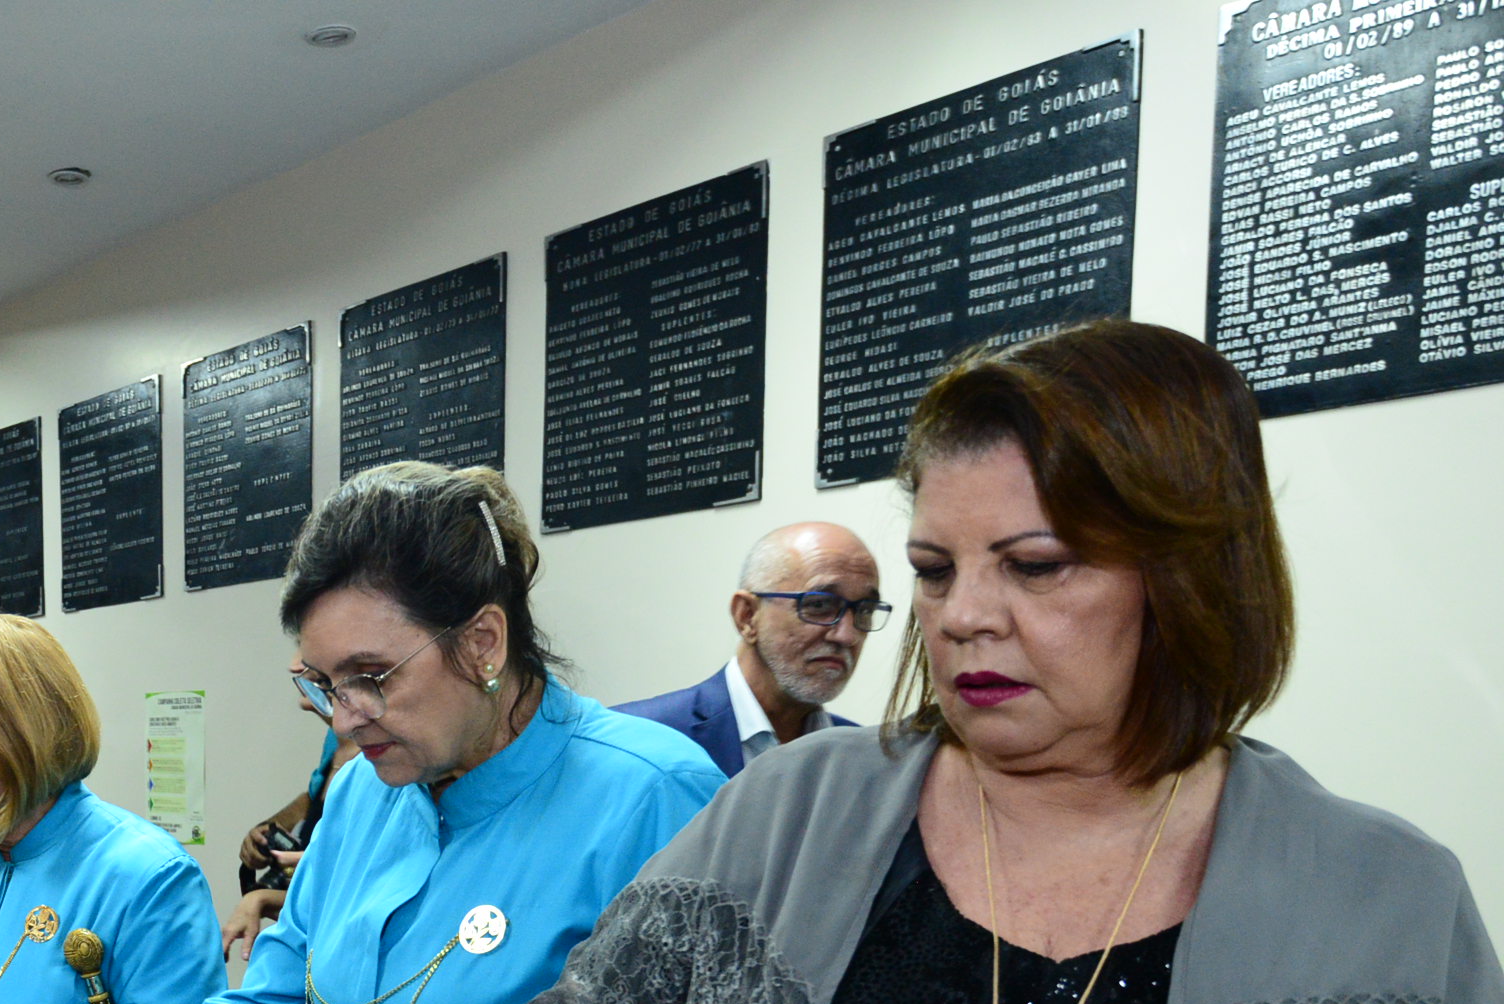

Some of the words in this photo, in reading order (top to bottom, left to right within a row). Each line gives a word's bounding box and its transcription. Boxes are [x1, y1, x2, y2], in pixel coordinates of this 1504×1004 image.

[1251, 1, 1342, 44] CÂMARA
[1265, 19, 1340, 60] DÉCIMA
[1349, 0, 1454, 33] PRIMEIR
[1323, 18, 1414, 62] 01/02/89
[1427, 10, 1440, 28] A
[1435, 58, 1479, 79] PAULO
[1436, 45, 1479, 67] PAULO
[1262, 60, 1360, 103] VEREADORES:
[1433, 78, 1500, 105] RONALDO
[1434, 71, 1480, 92] PEDRO
[887, 105, 950, 140] ESTADO
[962, 94, 983, 115] DE
[998, 68, 1059, 102] GOIÁS
[1225, 109, 1258, 127] AGEU
[1262, 86, 1338, 116] CAVALCANTE
[1342, 72, 1385, 93] LEMOS
[1433, 92, 1494, 118] ROSIRON
[835, 149, 896, 181] CÂMARA
[908, 116, 996, 158] MUNICIPAL
[1008, 106, 1029, 126] DE
[1040, 77, 1120, 116] GOIÂNIA
[1225, 117, 1275, 139] ANSELMO
[1278, 101, 1327, 124] PEREIRA
[1225, 127, 1276, 150] ANTÔNIO
[1281, 112, 1330, 134] CARLOS
[1334, 98, 1378, 119] RAMOS
[1430, 116, 1502, 144] SEBASTIÃO
[1431, 101, 1504, 131] SEBASTIÃO
[1047, 126, 1058, 140] A
[1224, 140, 1276, 162] ANTÔNIO
[1328, 107, 1393, 134] SOBRINHO
[1268, 150, 1286, 162] DE
[1288, 133, 1346, 157] ALENCAR
[1430, 136, 1478, 157] VALDIR
[1223, 166, 1269, 186] CARLOS
[1273, 153, 1317, 173] EURICO
[1322, 148, 1338, 160] DE
[1342, 143, 1356, 155] C.
[1359, 131, 1399, 150] ALVES
[1429, 148, 1482, 170] WALTER
[1221, 192, 1261, 210] DENISE
[1264, 174, 1329, 199] APARECIDA
[1333, 169, 1351, 182] DE
[1354, 151, 1419, 176] CARVALHO
[1222, 181, 1256, 198] DARCI
[1260, 167, 1312, 188] ACCORSI
[644, 208, 658, 223] DE
[669, 187, 712, 215] GOIÁS
[931, 204, 965, 221] LEMOS
[1221, 204, 1260, 222] EDVAN
[1264, 190, 1315, 211] PEREIRA
[1319, 176, 1372, 197] CAMPOS
[1426, 201, 1481, 222] CARLOS
[611, 225, 669, 255] MUNICIPAL
[678, 217, 692, 233] DE
[698, 197, 751, 226] GOIÂNIA
[1089, 215, 1124, 232] GOMES
[1220, 217, 1254, 234] ELIAS
[1258, 208, 1293, 224] RASSI
[1298, 198, 1331, 215] NETO
[1220, 225, 1275, 246] GERALDO
[1279, 211, 1330, 232] PEREIRA
[1333, 204, 1360, 219] DOS
[1363, 191, 1413, 212] SANTOS
[1426, 215, 1478, 235] DJALMA
[1483, 210, 1499, 223] C.
[970, 230, 999, 246] PAULO
[1219, 242, 1254, 258] JAMIR
[1257, 230, 1304, 249] SOARES
[1307, 216, 1354, 238] FALCÃO
[1219, 253, 1251, 269] JOÃO
[1254, 242, 1302, 261] SANDES
[1305, 231, 1351, 250] JÚNIOR
[1424, 237, 1495, 261] DORACINO
[1425, 229, 1472, 248] DANIEL
[902, 246, 942, 264] CAMPOS
[1218, 263, 1249, 281] JOSÉ
[1253, 253, 1309, 274] EDUARDO
[1312, 249, 1325, 261] S.
[1328, 230, 1408, 257] NASCIMENTO
[1424, 257, 1466, 274] EDSON
[918, 267, 927, 277] DE
[1022, 270, 1055, 286] VIEIRA
[1059, 265, 1073, 277] DE
[1078, 257, 1107, 272] MELO
[1217, 287, 1248, 304] JOSÉ
[1253, 278, 1304, 297] LUCIANO
[1307, 274, 1323, 286] DA
[1329, 260, 1387, 281] FONSECA
[1218, 275, 1249, 293] JOSÉ
[1253, 269, 1292, 285] HIDASI
[1295, 260, 1332, 276] FILHO
[1422, 269, 1466, 287] EULER
[1471, 264, 1493, 277] IVO
[413, 288, 424, 301] DE
[431, 273, 463, 295] GOIÁS
[865, 292, 894, 307] ALVES
[898, 282, 936, 299] PEREIRA
[967, 300, 1004, 316] VALDIR
[1008, 288, 1036, 307] JOSÉ
[1040, 288, 1054, 299] DO
[1058, 278, 1095, 295] PRADO
[1422, 283, 1459, 299] JAMIL
[388, 305, 431, 328] MUNICIPAL
[438, 299, 448, 312] DE
[1216, 312, 1257, 328] JOVAIR
[1262, 299, 1317, 319] OLIVEIRA
[1322, 287, 1379, 307] ARANTES
[1217, 299, 1248, 316] JOSÉ
[1253, 293, 1290, 309] NELTO
[1420, 305, 1477, 325] LUCIANO
[1421, 296, 1460, 312] JAIME
[1216, 326, 1242, 340] LUIZ
[1246, 318, 1285, 334] CEZAR
[1289, 313, 1308, 326] DO
[1312, 310, 1325, 321] A.
[1328, 302, 1366, 318] MUNIZ
[1216, 337, 1250, 351] MARIA
[1253, 334, 1264, 344] R.
[1279, 320, 1335, 339] CRUVINEL
[1419, 321, 1467, 338] MISAEL
[1259, 350, 1291, 367] JOSÉ
[1294, 348, 1318, 361] DAS
[1323, 338, 1373, 356] MERCEZ
[1261, 334, 1325, 355] PIGNATARO
[1329, 321, 1397, 342] SANT'ANNA
[1419, 335, 1463, 350] OLÍVIA
[868, 359, 895, 372] ALVES
[898, 356, 909, 366] DE
[913, 348, 944, 363] SOUZA
[1418, 347, 1466, 363] OTÁVIO
[1246, 366, 1286, 380] PREGO
[1253, 373, 1311, 391] HENRIQUE
[1314, 360, 1386, 381] BERNARDES
[850, 446, 876, 458] SILVA
